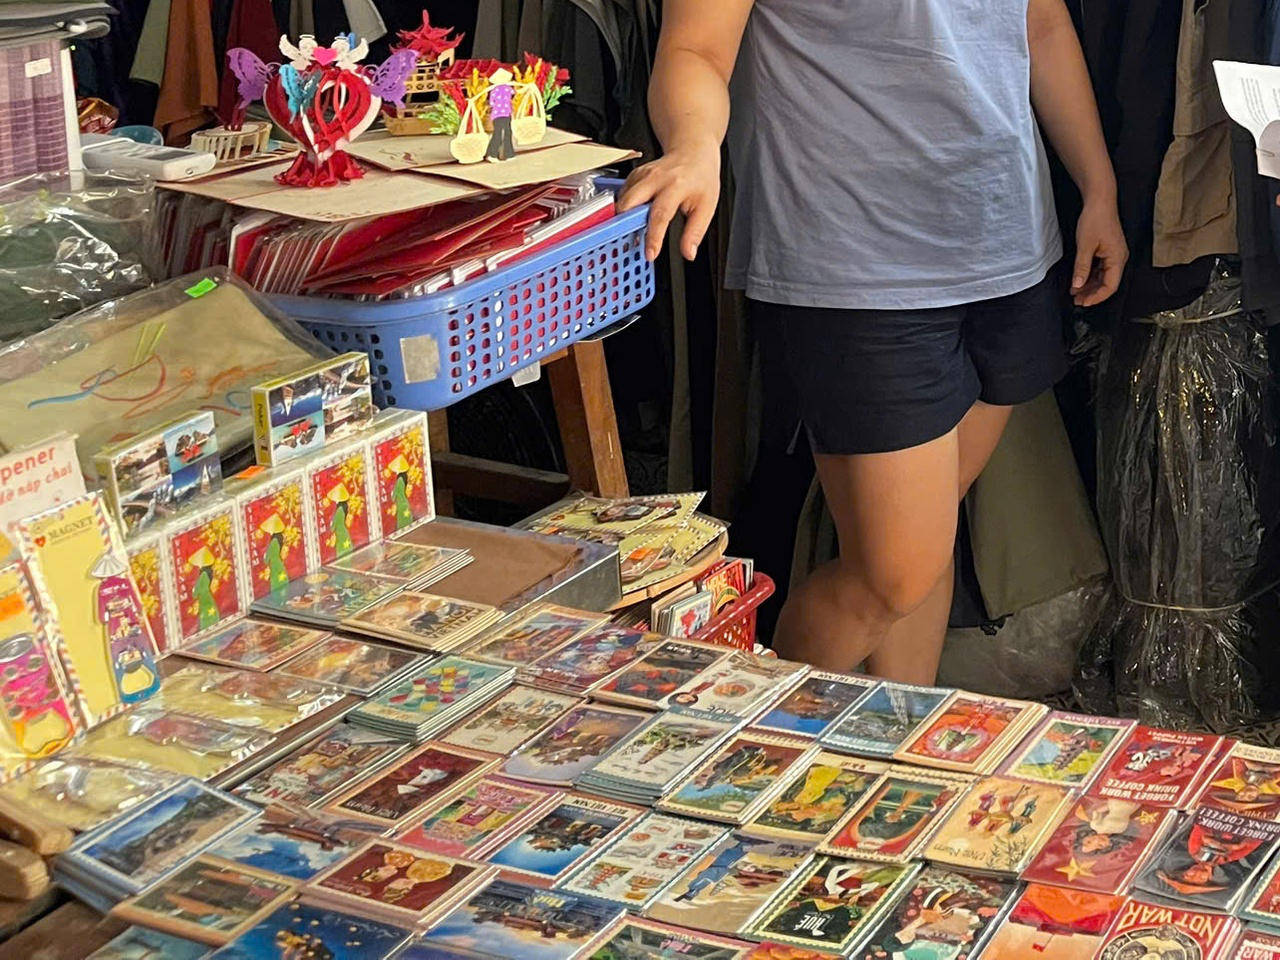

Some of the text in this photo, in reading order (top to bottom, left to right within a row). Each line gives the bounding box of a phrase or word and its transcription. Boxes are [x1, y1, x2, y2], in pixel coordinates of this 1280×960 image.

[1105, 778, 1180, 793] DRINK COFFEE
[1099, 787, 1175, 801] FORGET WORK
[1232, 825, 1275, 841] FORGET
[1120, 902, 1224, 946] NOT WAR
